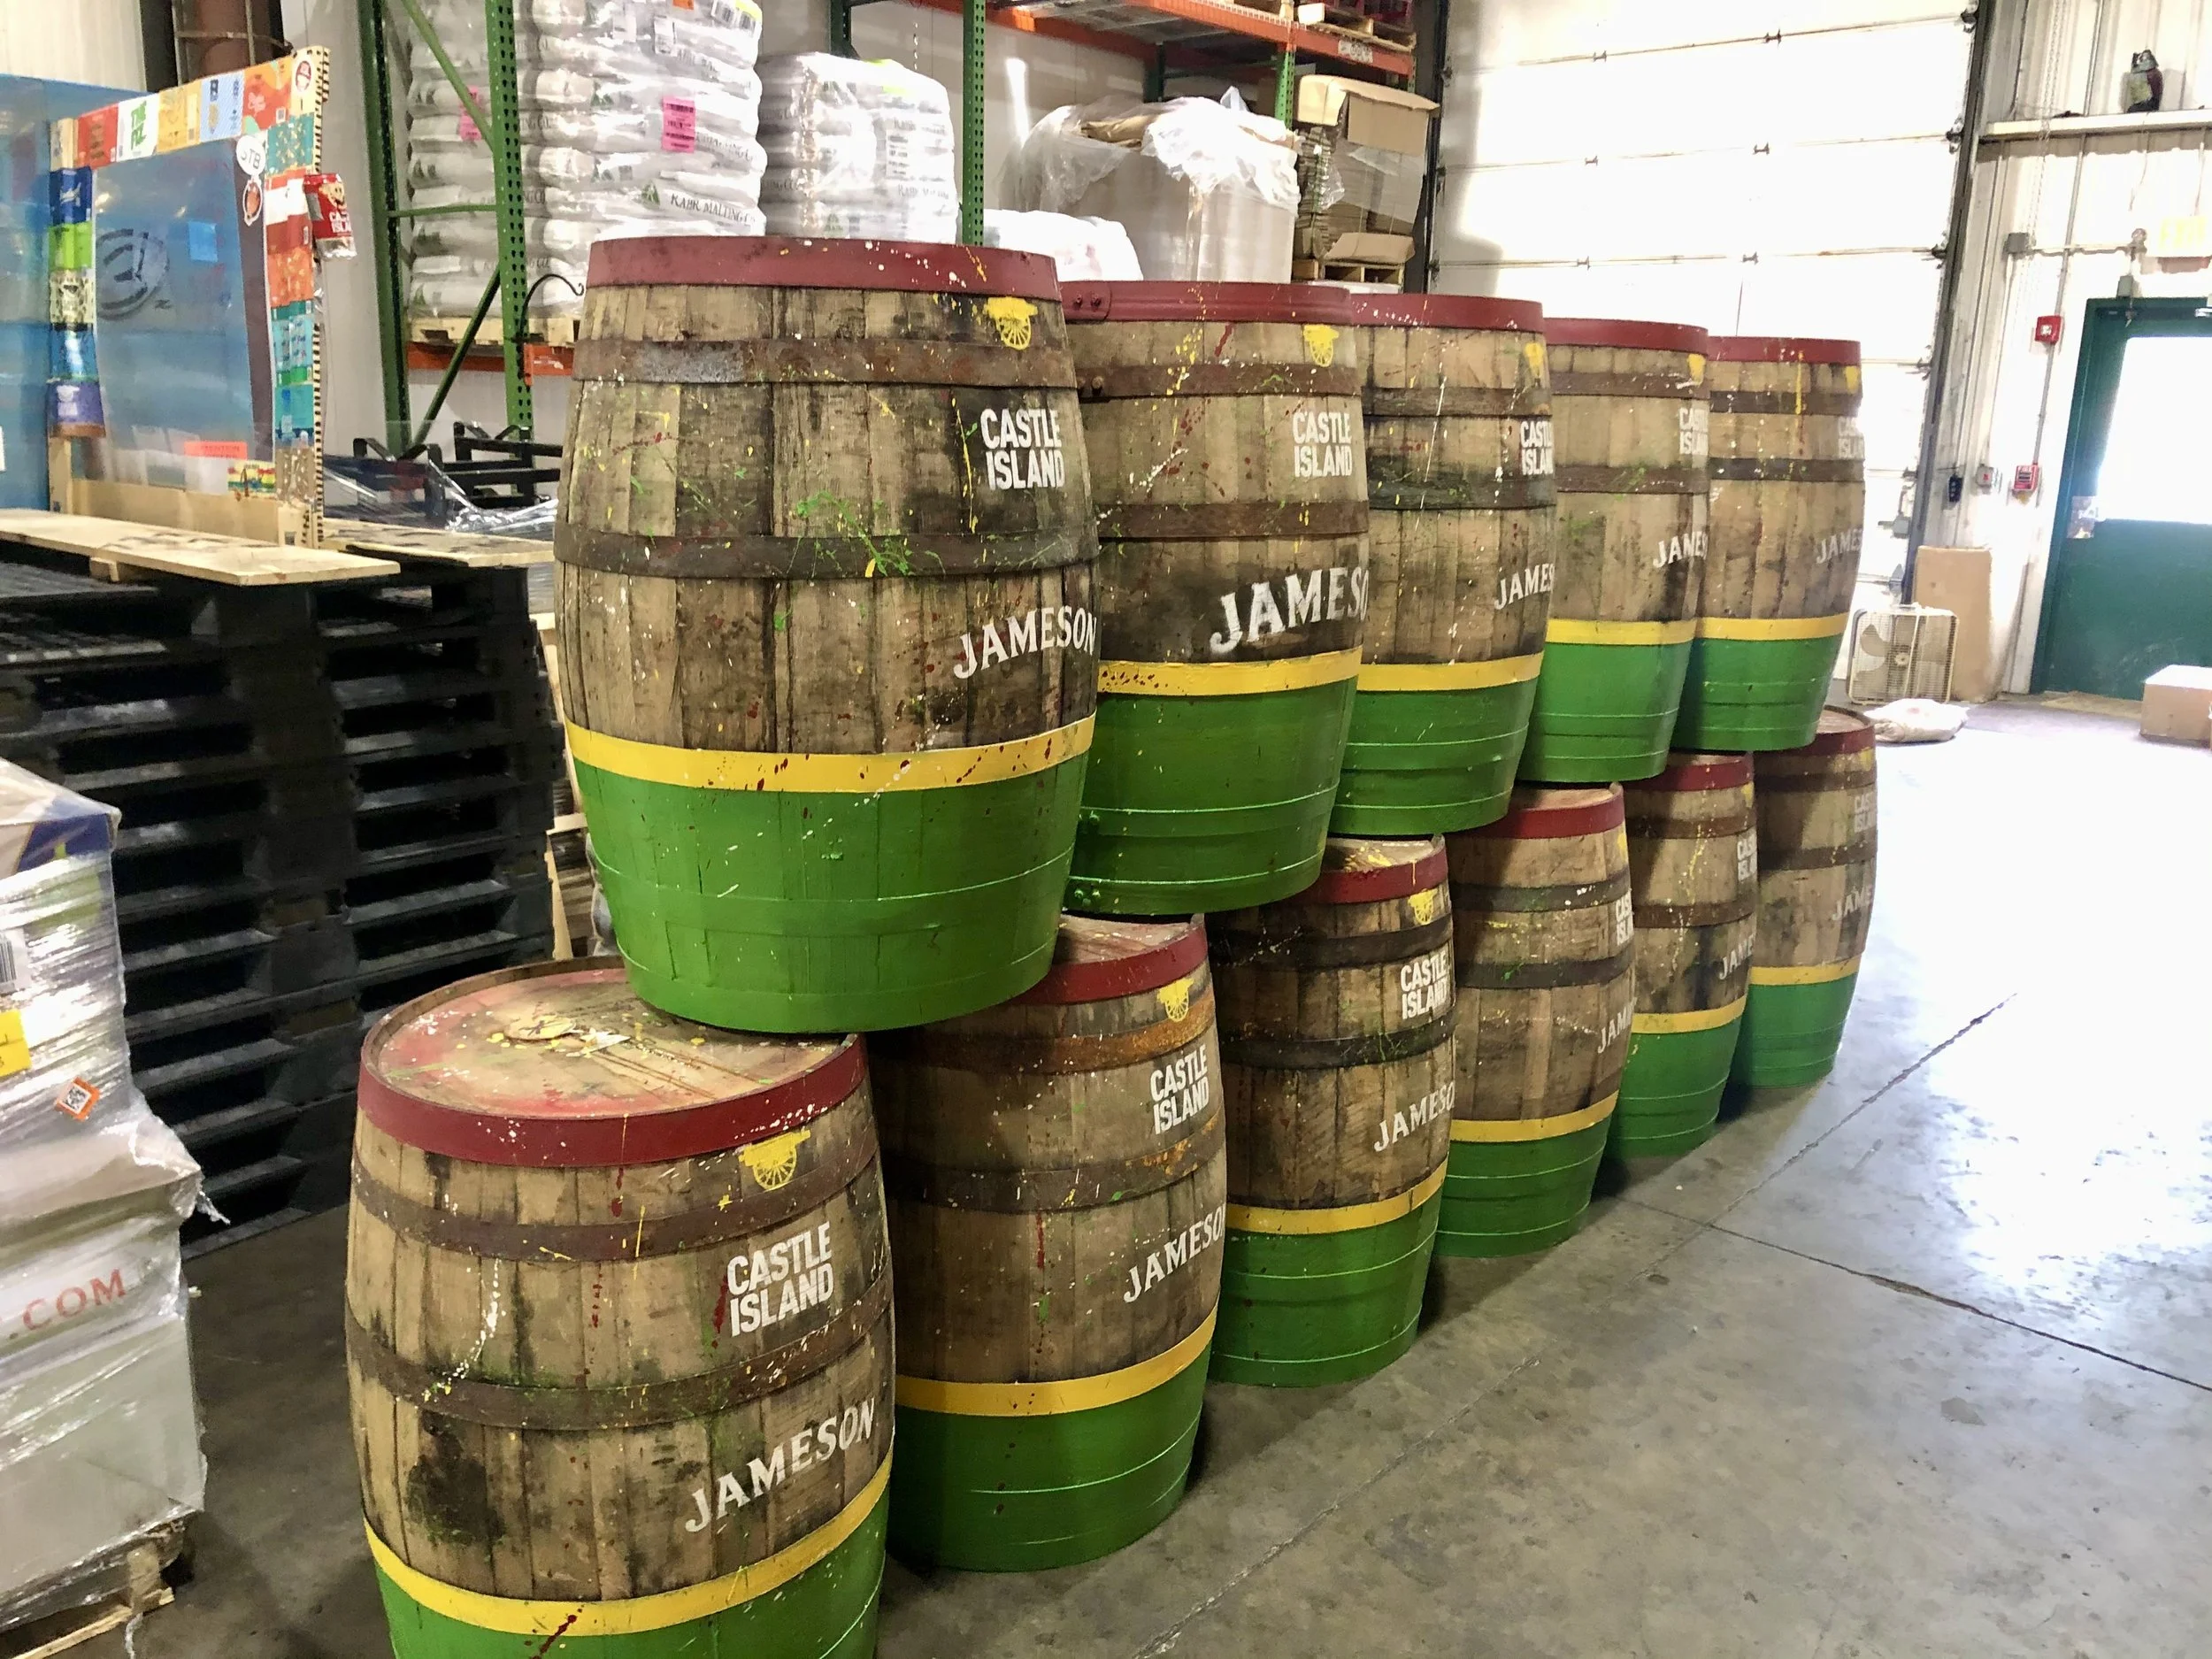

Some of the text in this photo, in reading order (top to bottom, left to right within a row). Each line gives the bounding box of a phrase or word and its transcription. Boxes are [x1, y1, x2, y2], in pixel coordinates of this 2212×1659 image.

[980, 409, 1061, 449] CASTLE
[1293, 411, 1352, 444] CASTLE
[986, 449, 1065, 490] ISLAND
[1294, 444, 1353, 478] ISLAND
[953, 605, 1097, 680] JAMESON
[1401, 949, 1448, 993] CASTLE
[1402, 976, 1449, 1020] ISLAND
[1150, 1044, 1209, 1102] CASTLE
[1153, 1079, 1210, 1135] ISLAND
[727, 1221, 831, 1296] CASTLE
[730, 1262, 835, 1337] ISLAND
[684, 1397, 876, 1534] JAMESON
